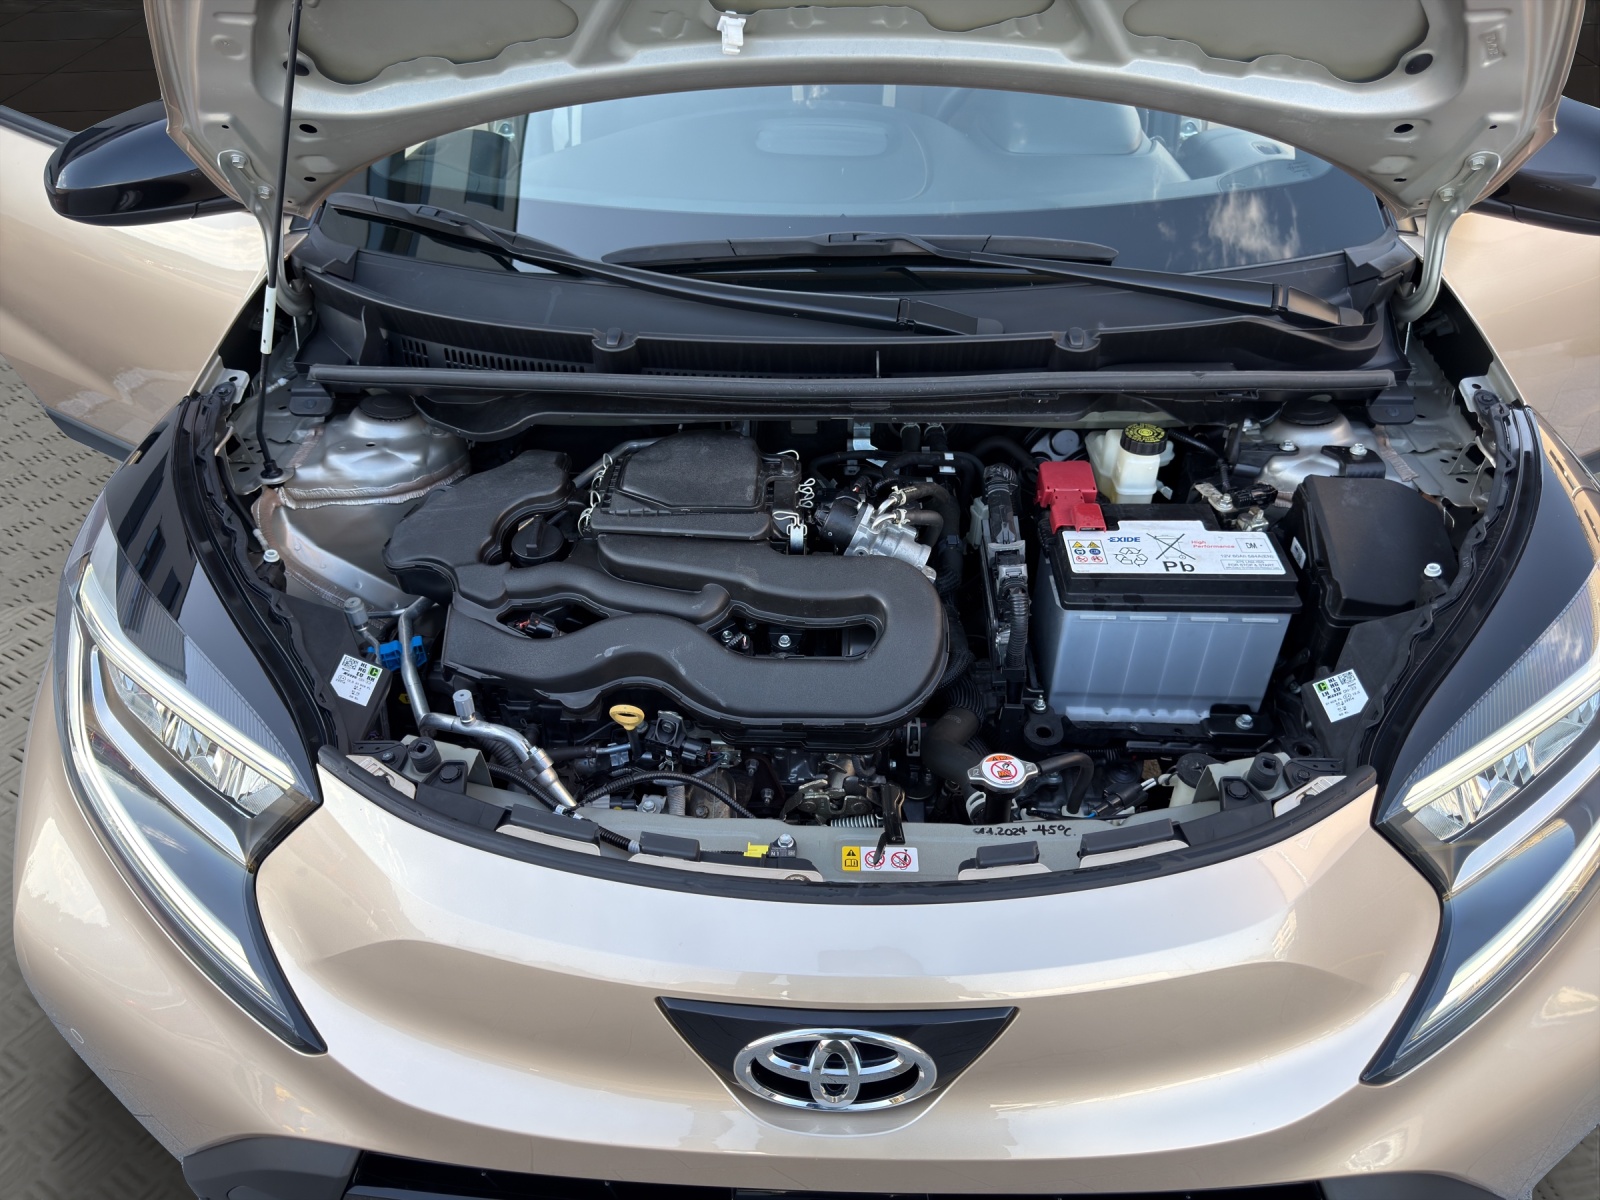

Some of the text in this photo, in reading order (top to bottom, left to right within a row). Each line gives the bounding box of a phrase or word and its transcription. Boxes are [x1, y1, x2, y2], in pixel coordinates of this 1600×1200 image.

[1163, 561, 1195, 572] Pb
[370, 667, 378, 676] C
[1318, 682, 1326, 691] C
